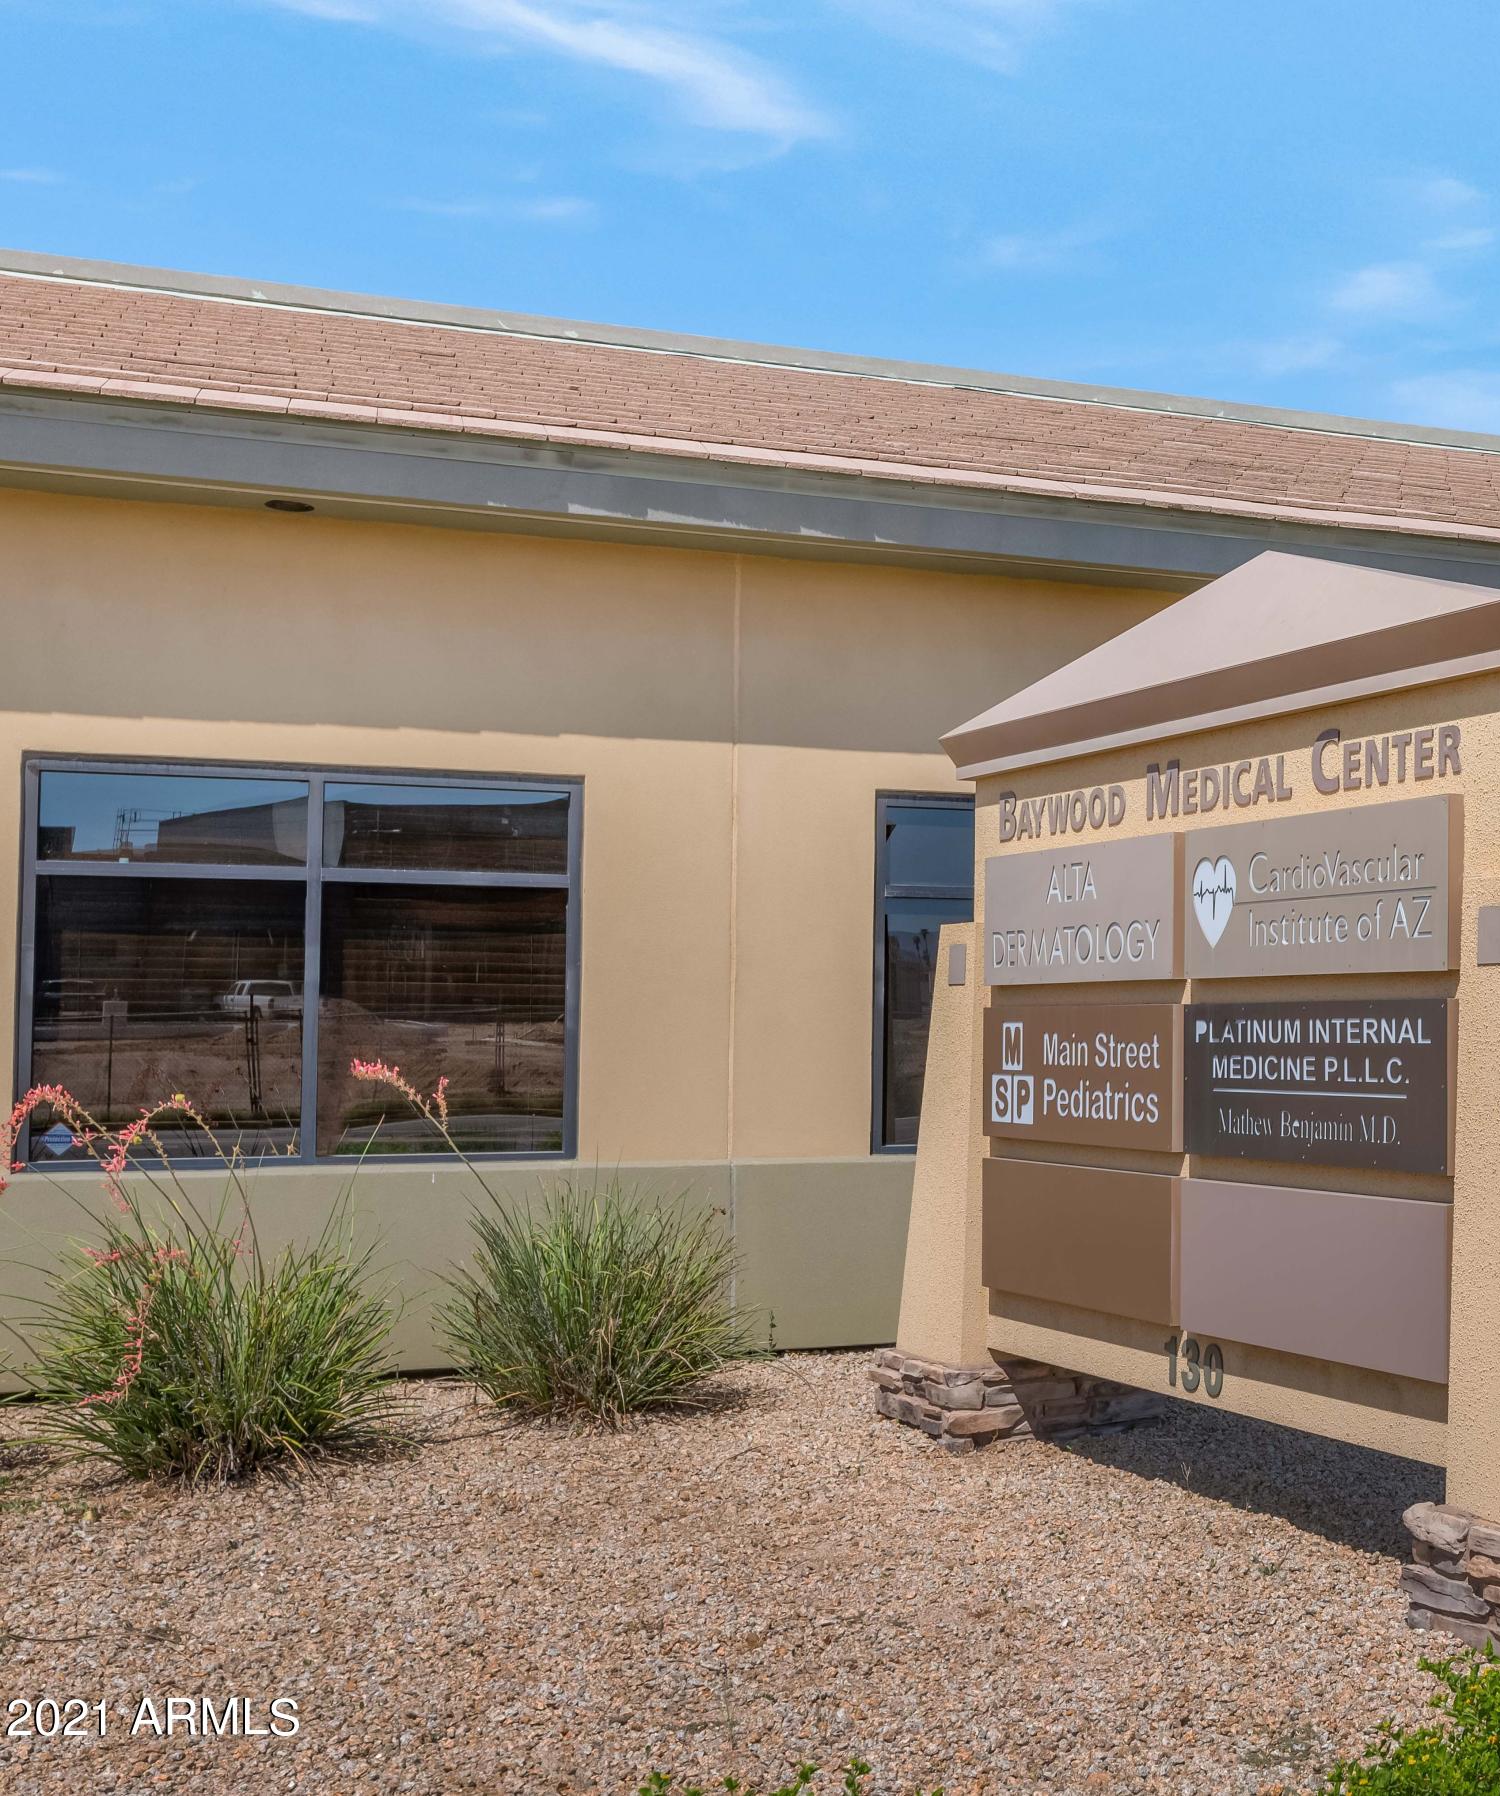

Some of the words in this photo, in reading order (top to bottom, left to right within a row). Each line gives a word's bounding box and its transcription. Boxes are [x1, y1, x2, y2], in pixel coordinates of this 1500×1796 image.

[999, 785, 1126, 842] BAYWOOD
[1145, 755, 1292, 820] MEDICAL
[1311, 725, 1462, 794] CENTER
[1046, 861, 1097, 904] ALTA
[1248, 843, 1424, 893] CardioVascular
[992, 919, 1160, 968] DERMATOLOGY
[1249, 908, 1348, 948] Institute
[1356, 899, 1385, 940] of
[1390, 895, 1433, 938] AZ
[1004, 1024, 1022, 1069] M
[1043, 1032, 1088, 1069] Main
[1095, 1034, 1160, 1070] Street
[1195, 1018, 1300, 1045] PLATINUM
[1309, 1018, 1431, 1045] INTERNAL
[1212, 1056, 1316, 1082] MEDICINE
[1323, 1056, 1409, 1085] P.L.L.C.
[1042, 1080, 1159, 1125] Pediatrics
[1218, 1108, 1273, 1138] Mathew
[1280, 1111, 1354, 1148] Benjamin
[1360, 1115, 1401, 1146] M.D.
[1163, 1335, 1224, 1398] 130
